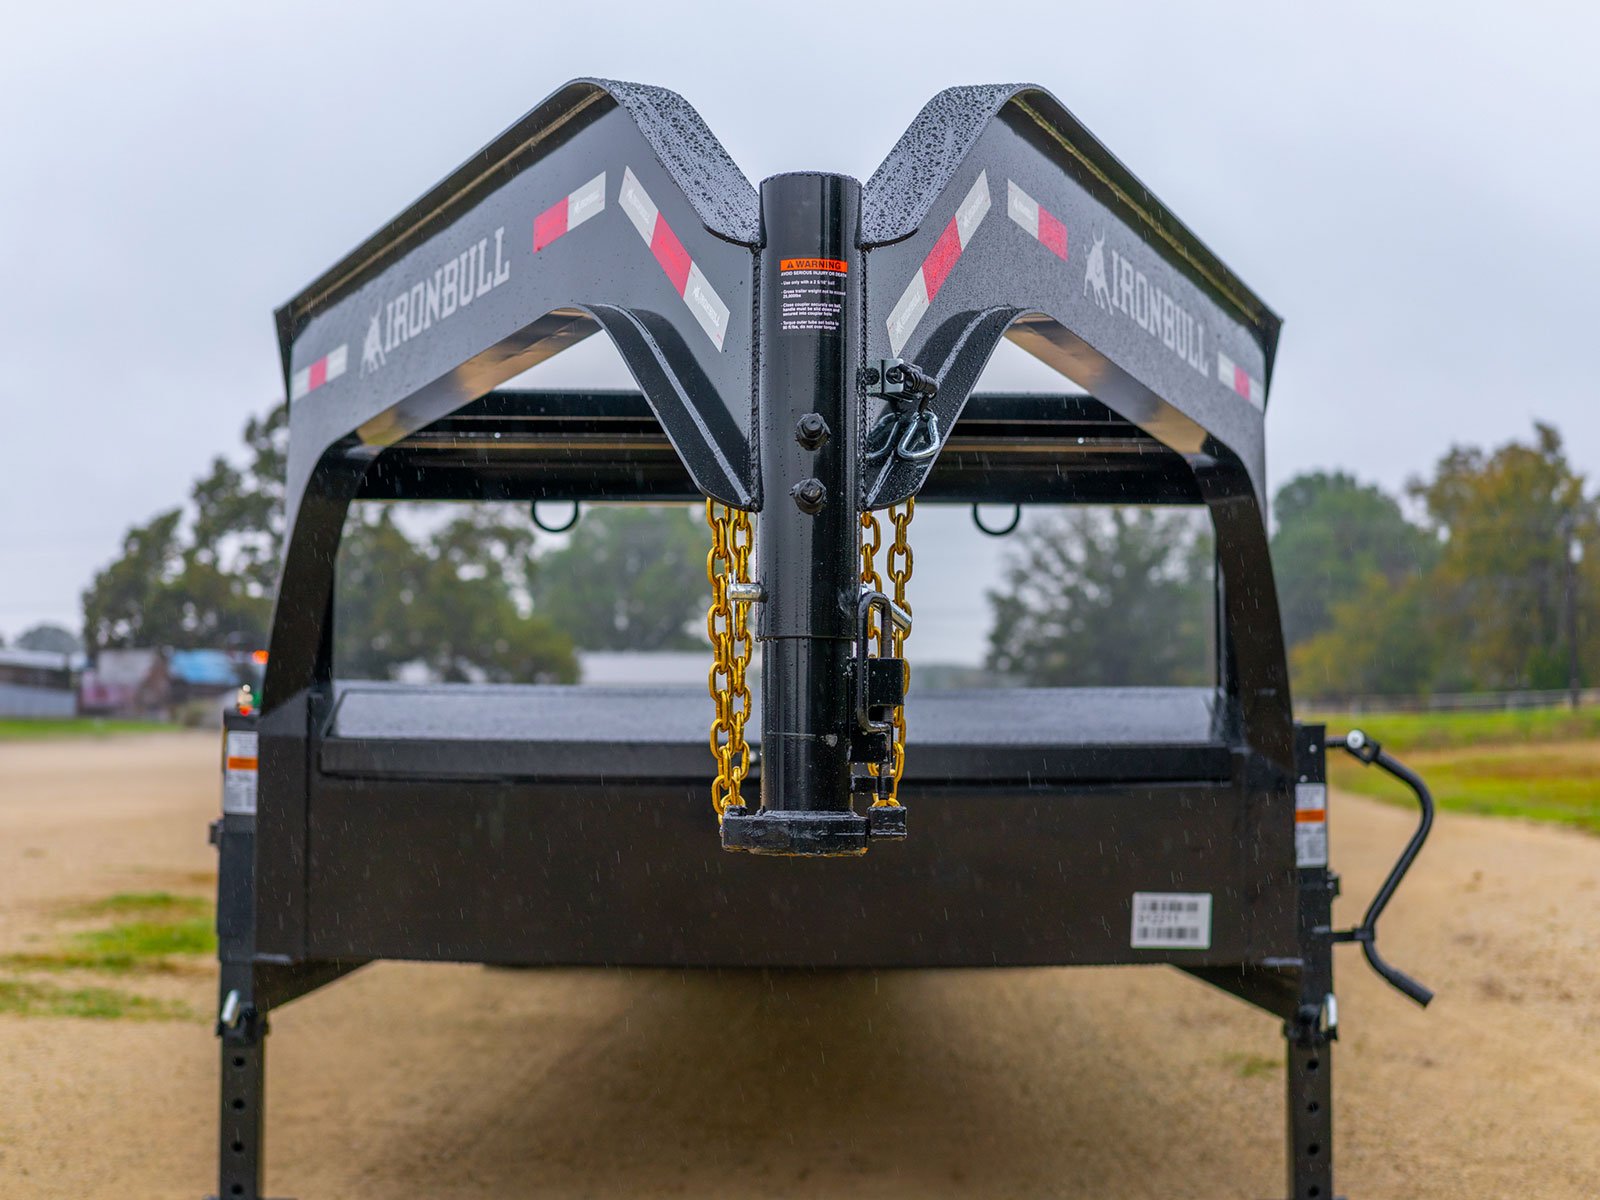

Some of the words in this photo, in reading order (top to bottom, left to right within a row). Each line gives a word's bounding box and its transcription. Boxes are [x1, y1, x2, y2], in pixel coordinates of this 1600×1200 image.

[385, 226, 510, 353] IRONBULL
[796, 260, 841, 269] WARNING
[1111, 250, 1210, 377] IRONBULL
